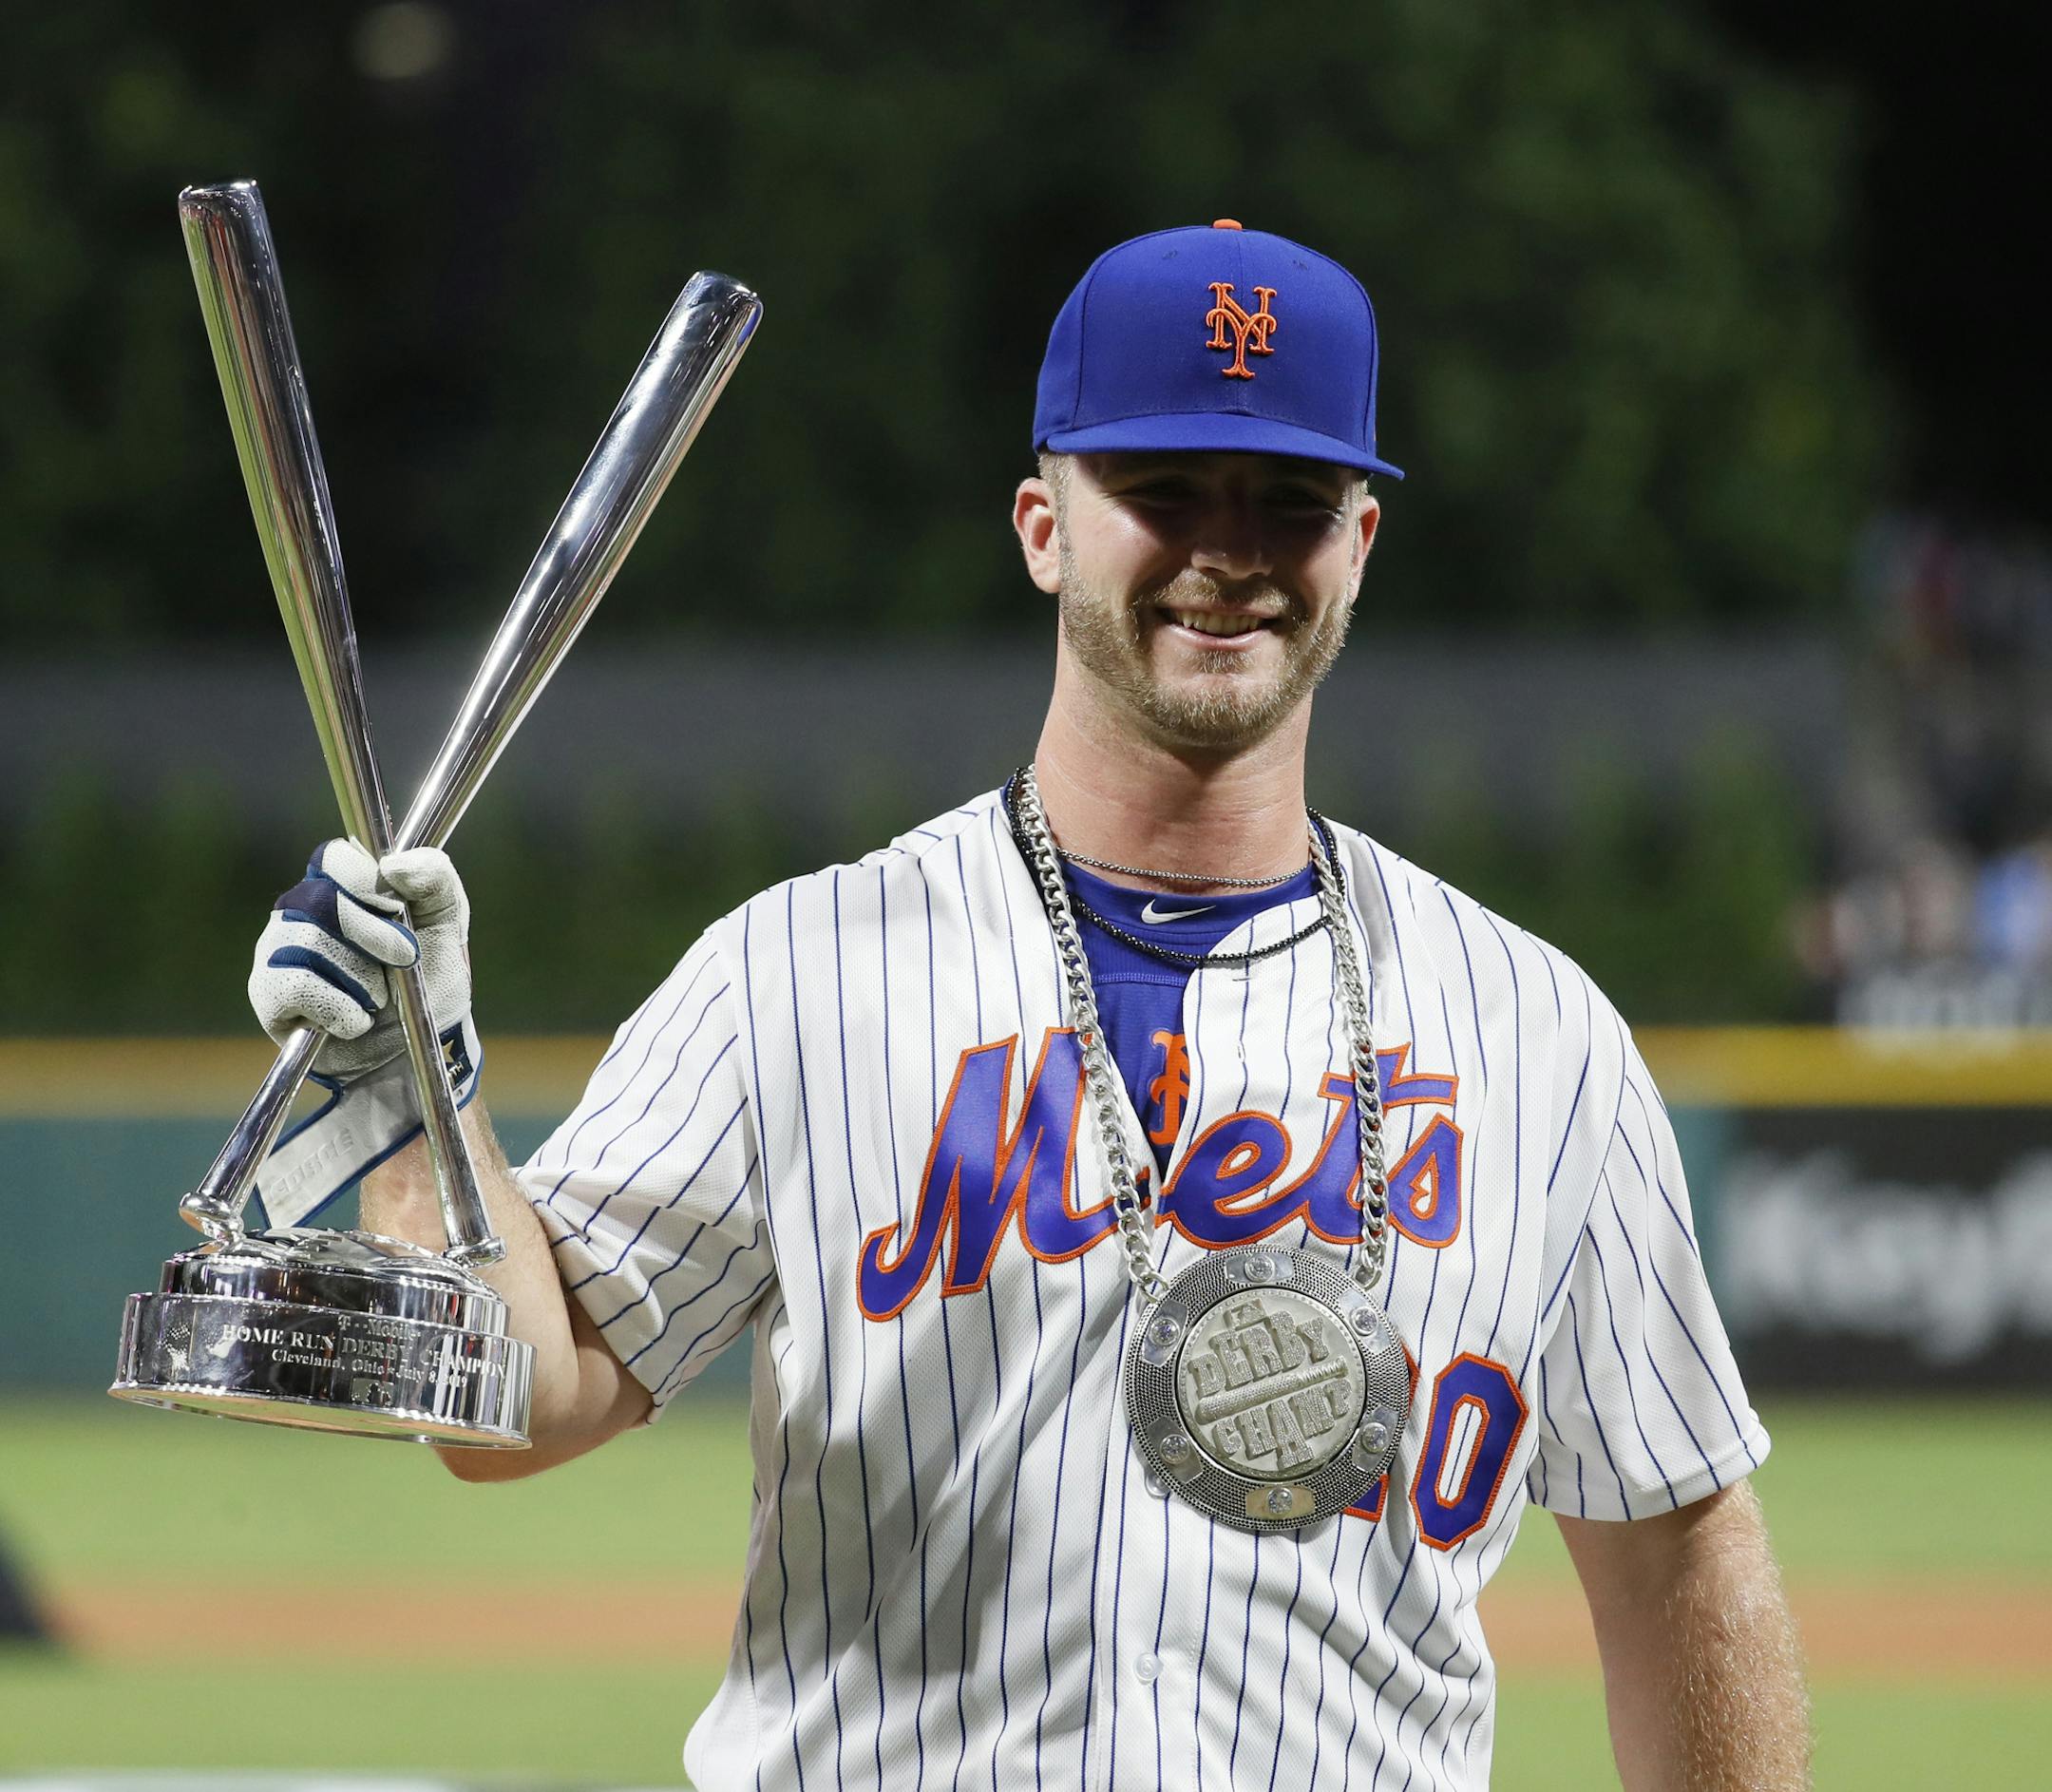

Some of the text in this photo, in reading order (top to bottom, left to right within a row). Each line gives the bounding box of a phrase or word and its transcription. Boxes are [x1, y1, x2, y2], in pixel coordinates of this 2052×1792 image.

[856, 1026, 1464, 1323] Mets
[222, 1324, 505, 1378] HOME RUN DERBY CHAMPION
[1188, 1310, 1330, 1399] DERBY
[1211, 1378, 1353, 1471] CHAMP
